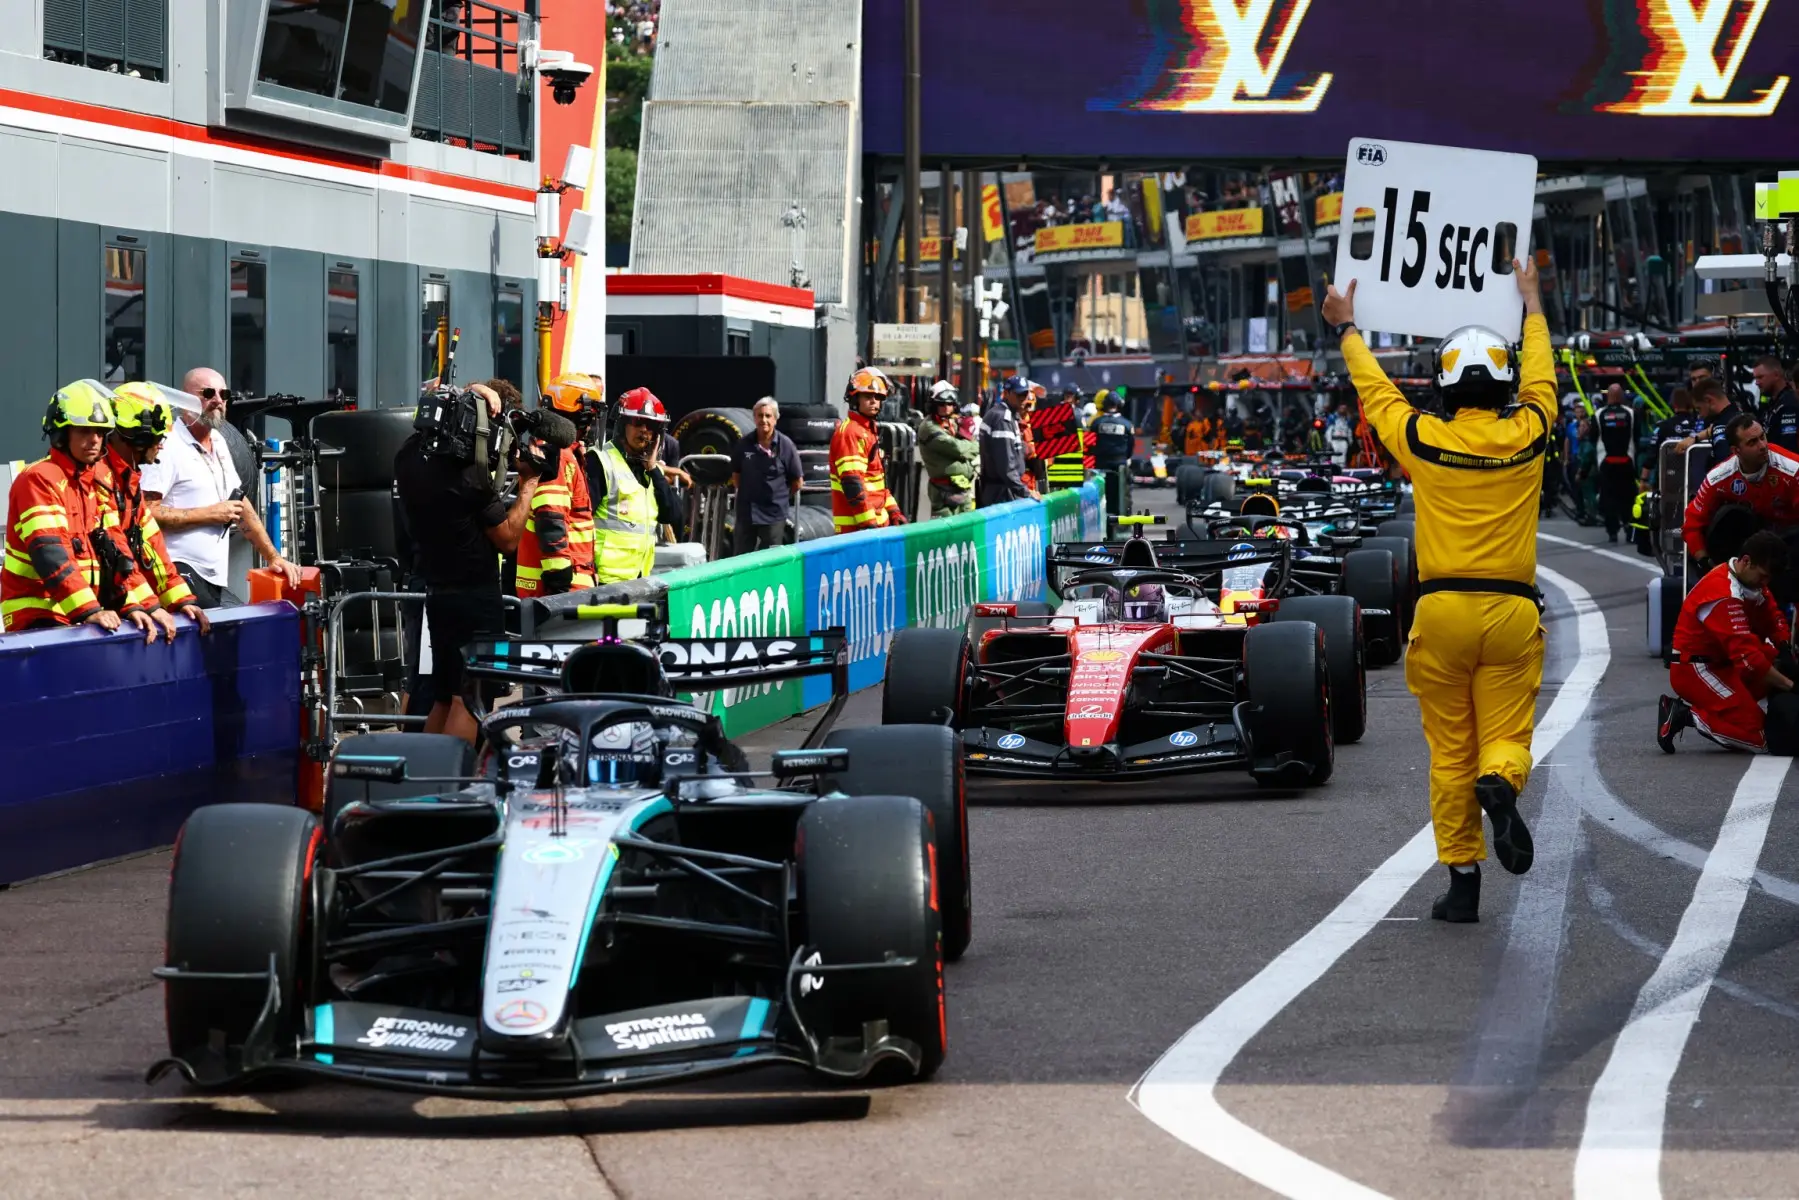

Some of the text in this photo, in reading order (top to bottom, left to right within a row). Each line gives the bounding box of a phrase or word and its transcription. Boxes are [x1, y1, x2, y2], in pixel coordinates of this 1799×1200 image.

[1380, 186, 1431, 288] 15
[1435, 223, 1489, 293] SEC
[1438, 452, 1483, 466] AUTOMOBILE
[1484, 458, 1502, 467] CLUB
[1502, 458, 1512, 466] DE
[1076, 664, 1125, 673] IBM
[1001, 734, 1023, 748] hp
[1173, 731, 1195, 745] hp
[508, 755, 538, 768] G42
[665, 753, 695, 765] G42
[373, 1016, 468, 1038] PETRONAS
[604, 1013, 706, 1036] PETRONAS
[357, 1027, 457, 1052] Syntium
[611, 1024, 715, 1050] Syntium
